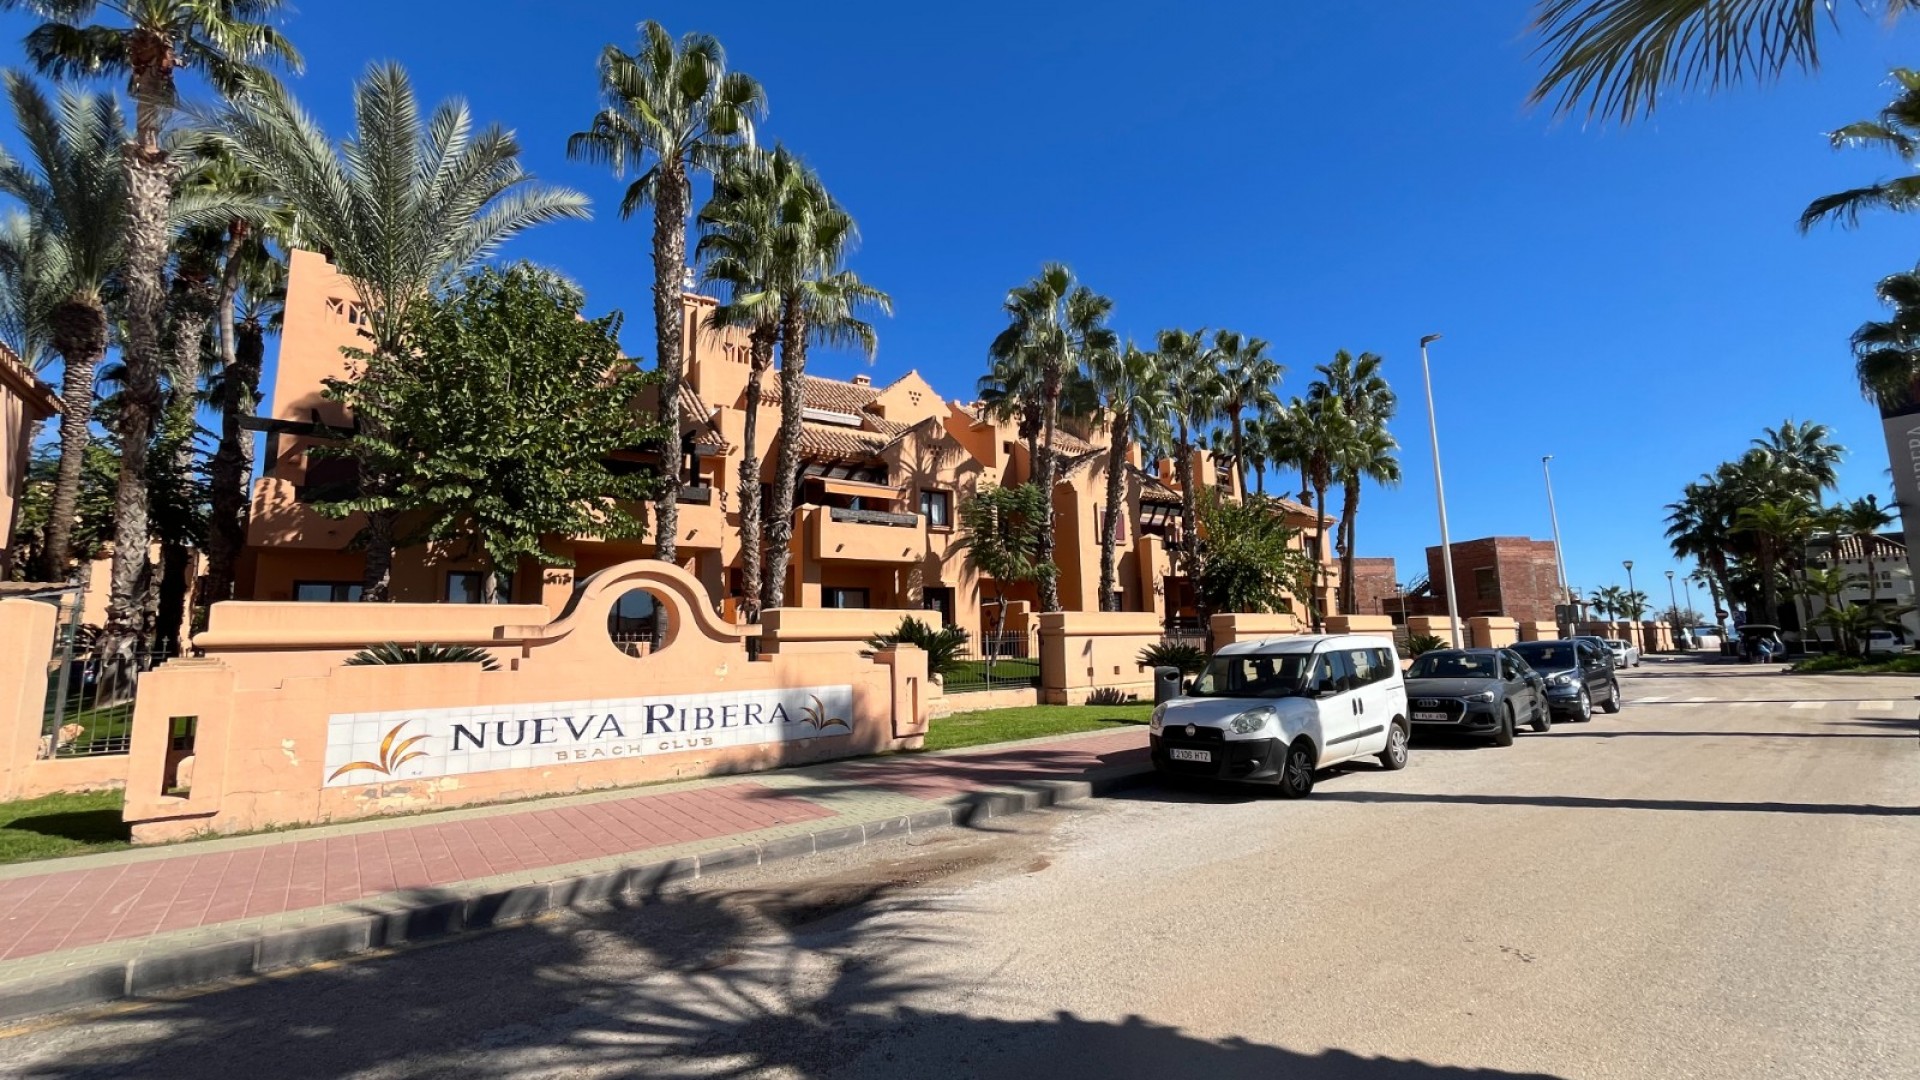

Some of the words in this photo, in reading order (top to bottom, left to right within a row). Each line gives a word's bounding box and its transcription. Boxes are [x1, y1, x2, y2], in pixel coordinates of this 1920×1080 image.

[449, 713, 625, 751] NUEVA
[642, 702, 791, 735] RIBERA
[555, 744, 641, 761] BEACH
[658, 737, 714, 751] CLUB
